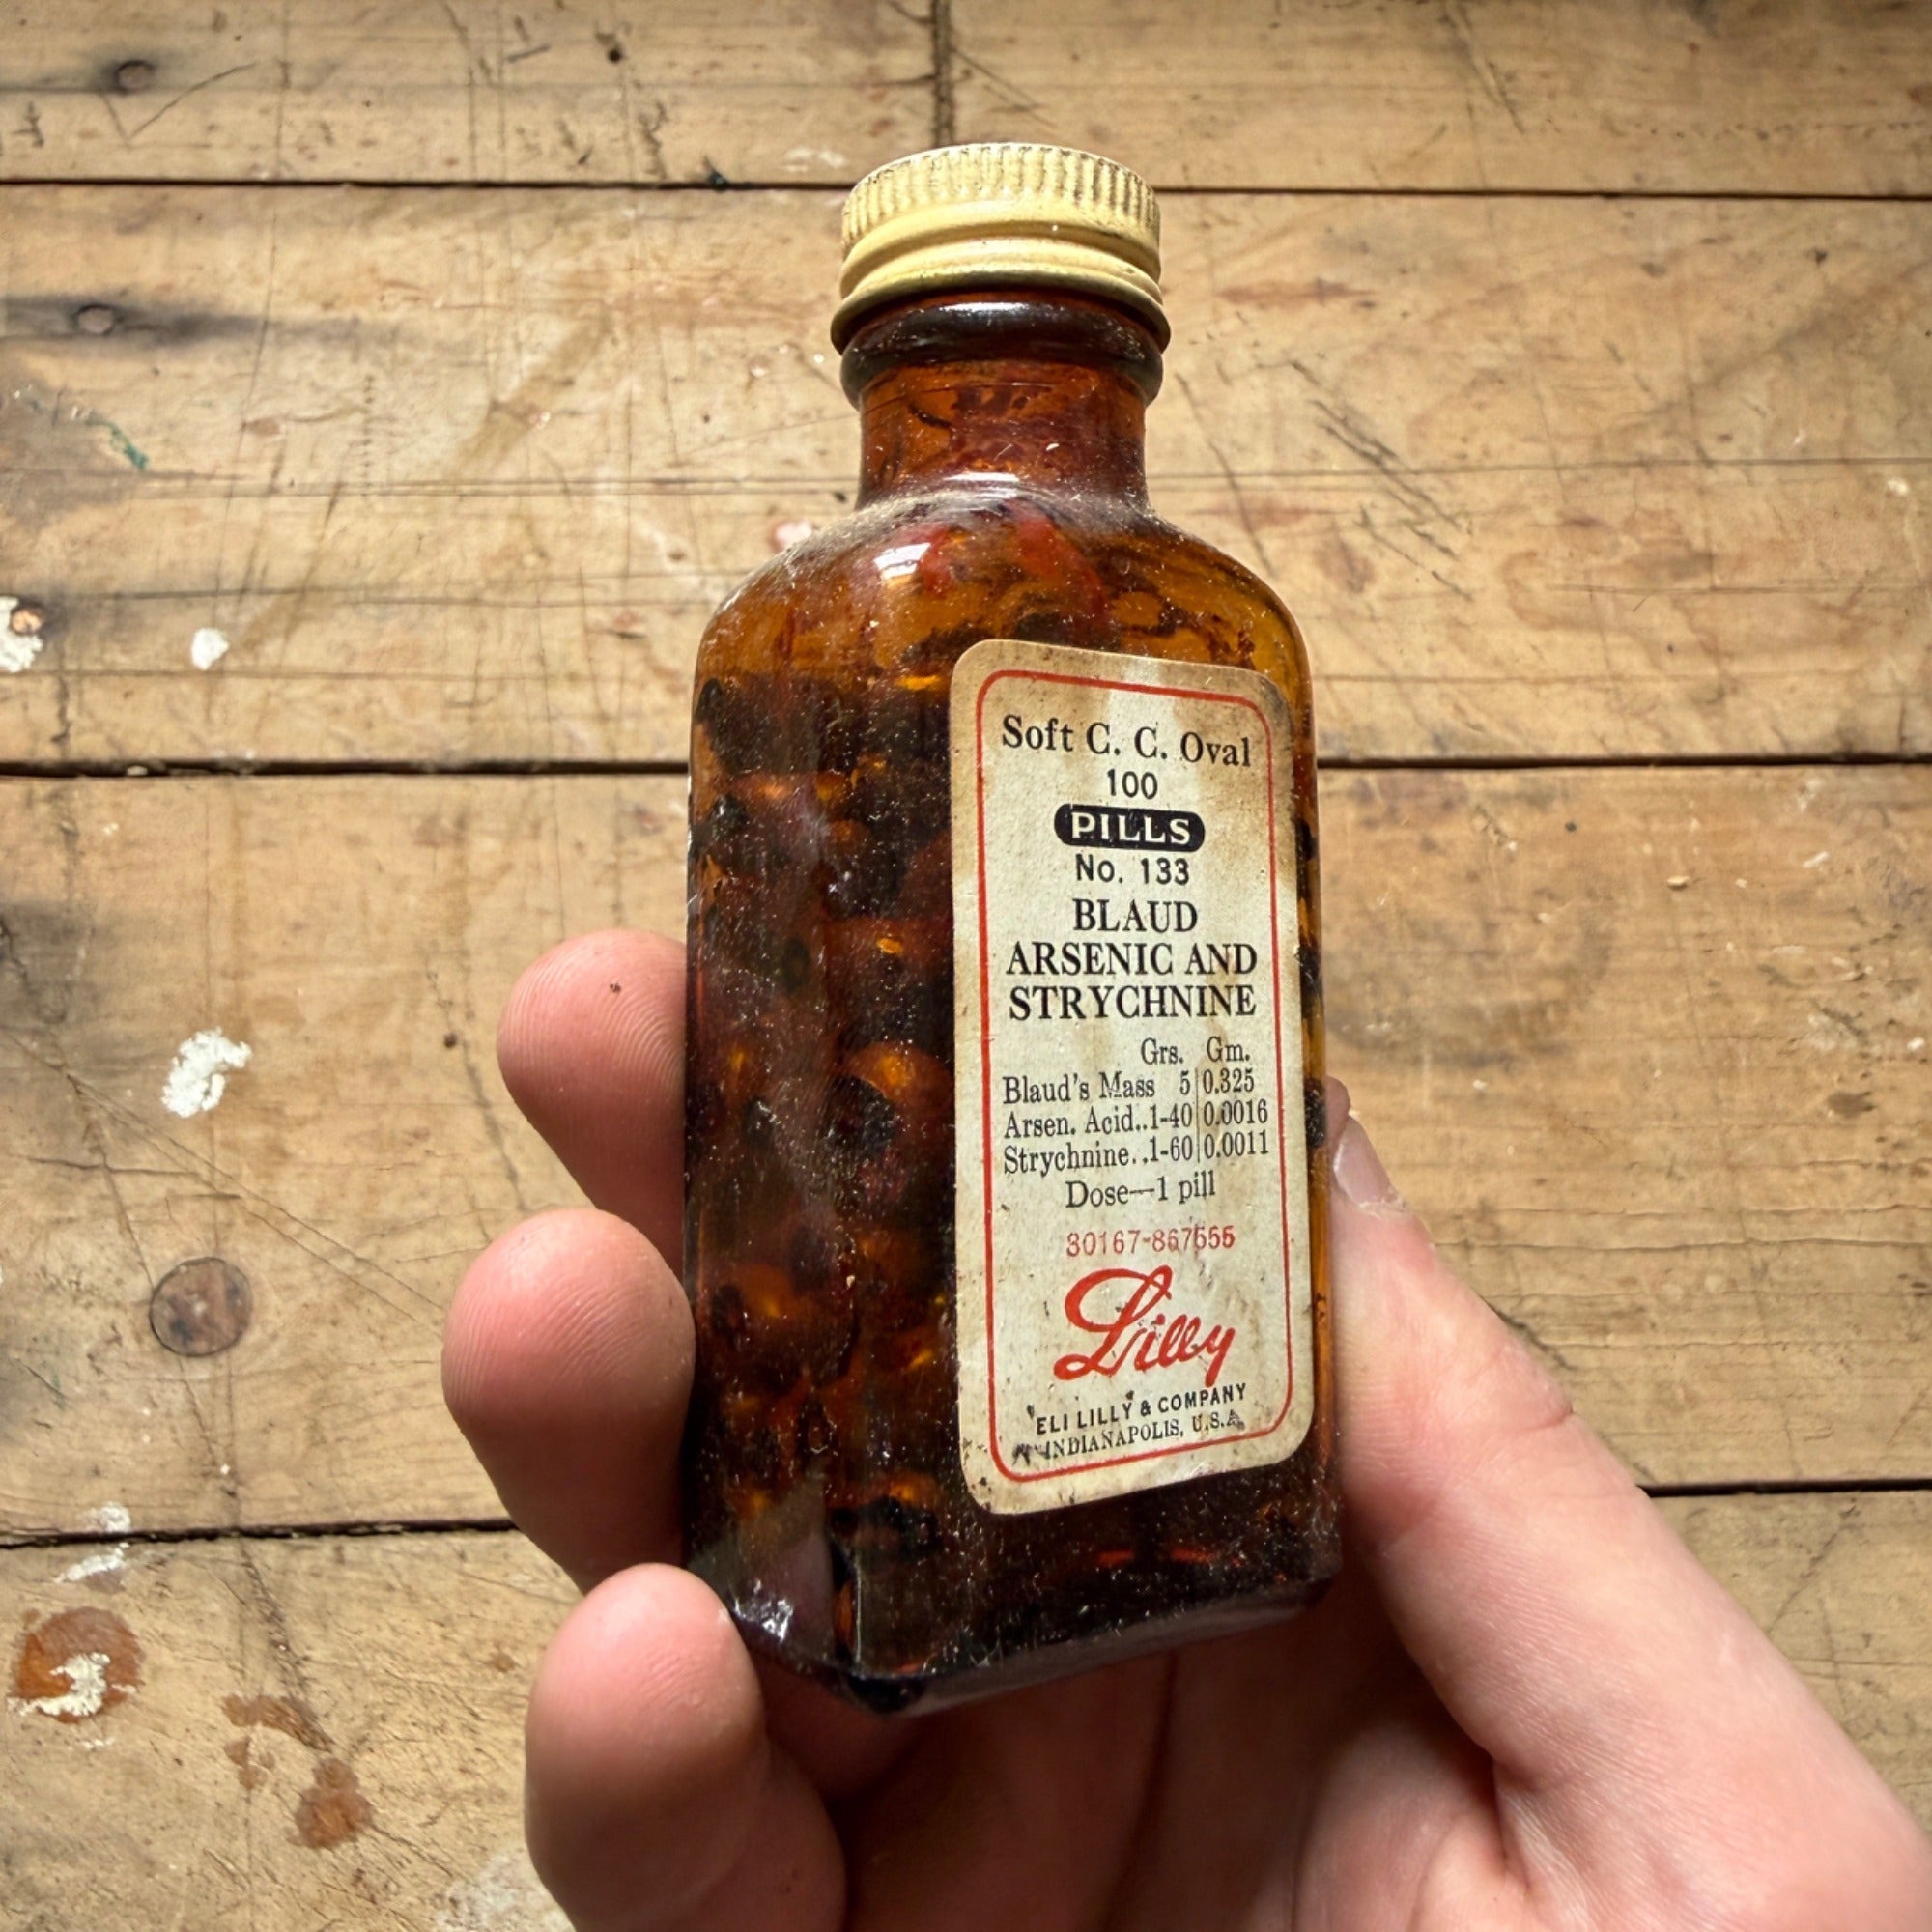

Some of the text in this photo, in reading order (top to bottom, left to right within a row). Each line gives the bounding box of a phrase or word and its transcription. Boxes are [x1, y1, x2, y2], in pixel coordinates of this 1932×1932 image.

[1002, 714, 1251, 767] Soft C. C. Oval
[1107, 768, 1158, 800] 100
[1071, 811, 1191, 845] PILLS
[1075, 853, 1190, 886] No. 133
[1072, 898, 1198, 933] BLAUD
[1006, 941, 1257, 976] ARSENIC AND
[1009, 984, 1257, 1021] STRYCHNINE
[1141, 1036, 1250, 1065] Grs. Gm.
[1003, 1067, 1255, 1104] Blaud's Mass 5 0.325
[1004, 1111, 1076, 1139] Arsen.
[1203, 1098, 1268, 1127] 0.0016
[1203, 1131, 1269, 1159] 0.0011
[1179, 1169, 1216, 1205] pill
[1054, 1264, 1236, 1387] Lilly
[1037, 1383, 1247, 1435] ELI LILLY & COMPANY
